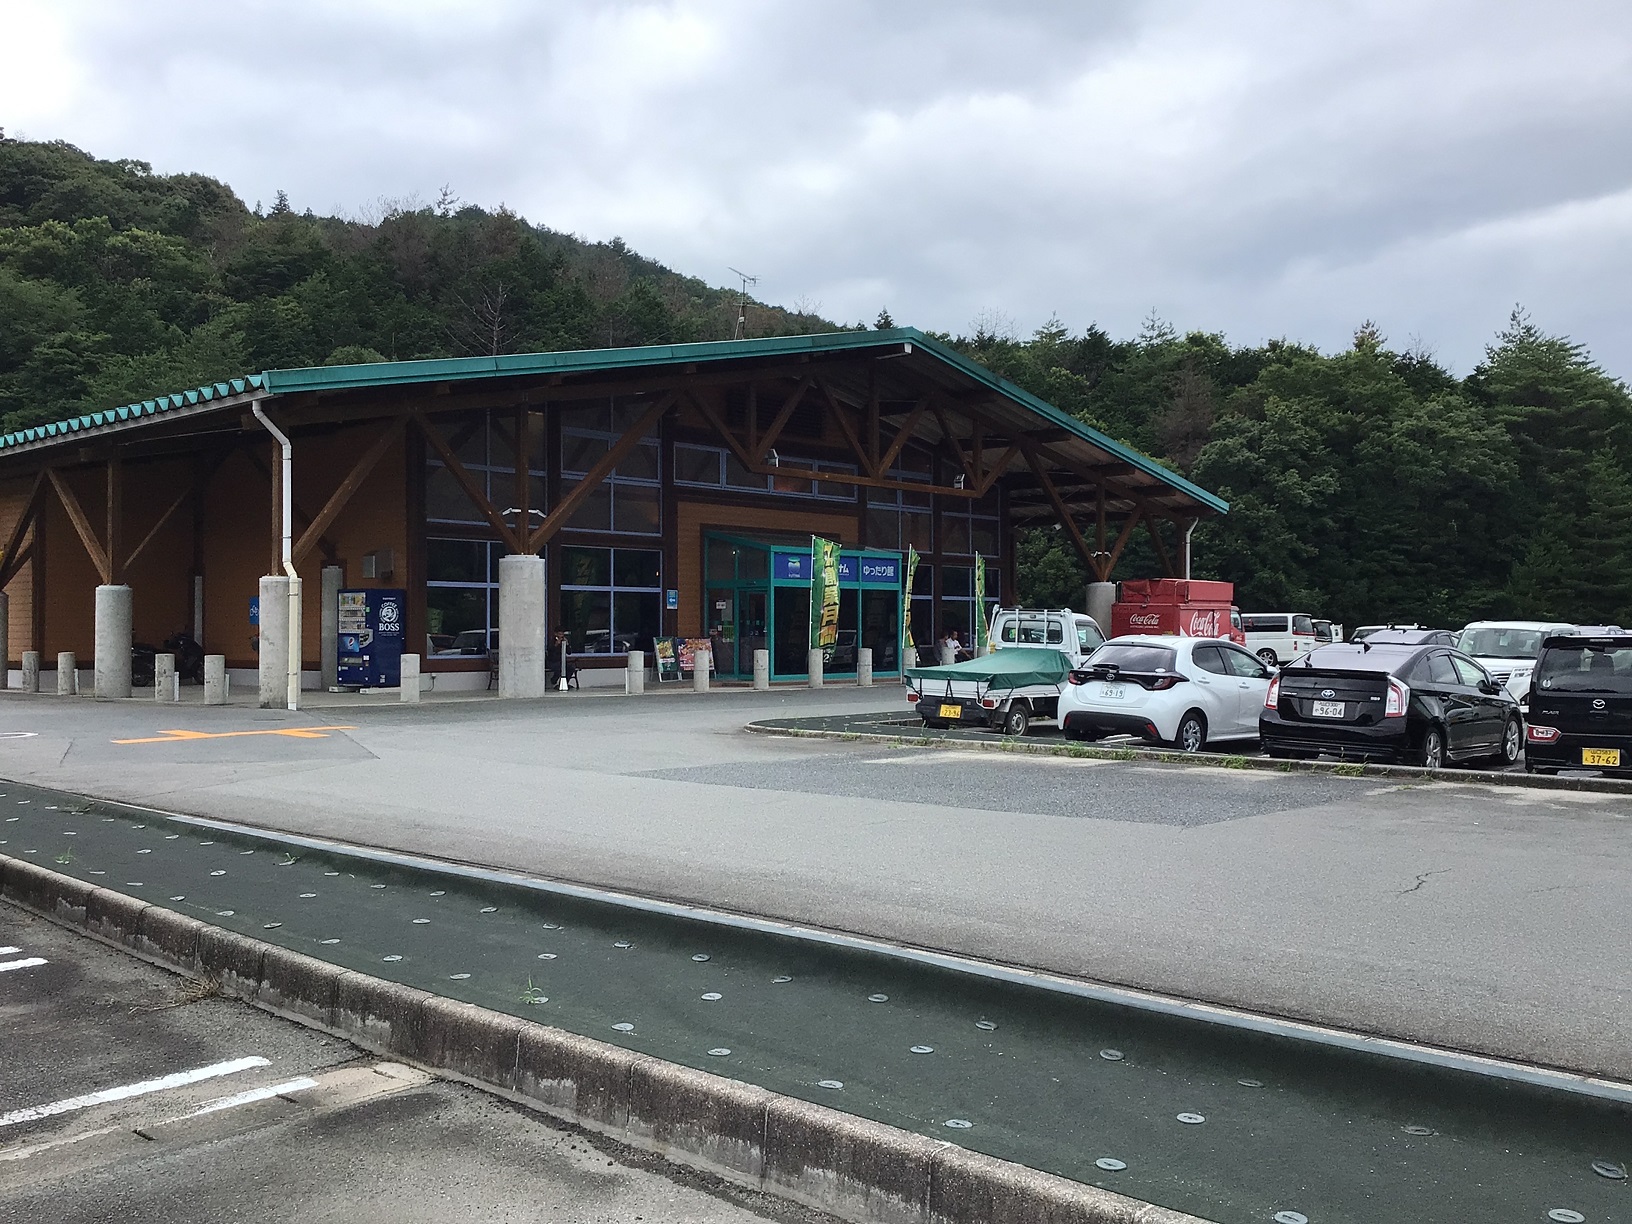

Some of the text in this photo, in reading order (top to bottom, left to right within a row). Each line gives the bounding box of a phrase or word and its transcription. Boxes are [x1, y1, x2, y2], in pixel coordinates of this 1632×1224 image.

[863, 565, 895, 577] ゆったり館
[1129, 613, 1161, 625] Coca-Cola
[1189, 611, 1221, 637] Coca-Cola
[379, 623, 400, 631] BOSS
[1319, 706, 1343, 717] 96-04
[1590, 754, 1618, 765] 37-62
